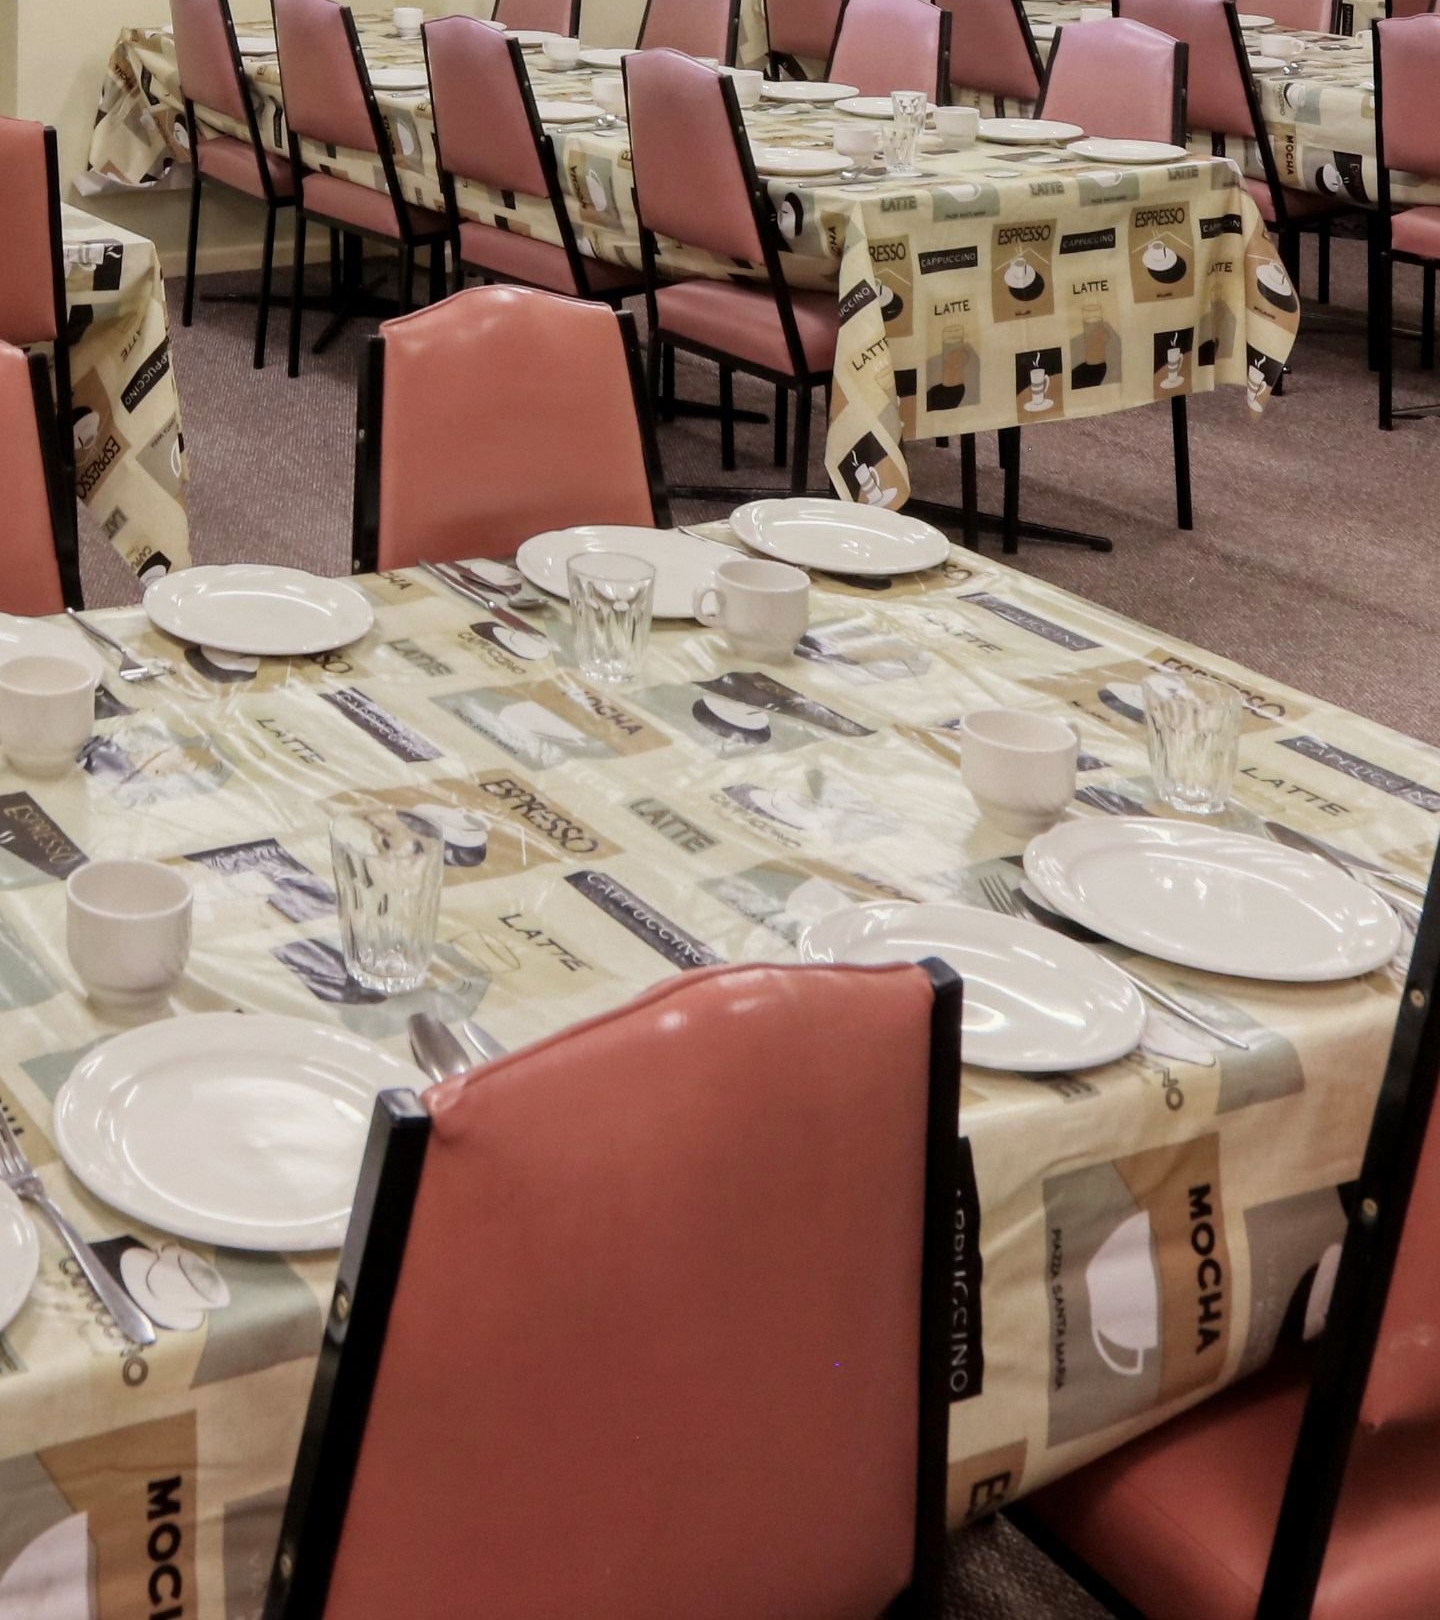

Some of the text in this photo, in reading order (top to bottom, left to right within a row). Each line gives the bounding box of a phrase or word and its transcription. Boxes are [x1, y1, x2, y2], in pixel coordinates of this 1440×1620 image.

[1285, 135, 1294, 175] MOCHA
[998, 225, 1051, 245] ESPRESSO
[1062, 234, 1114, 248] CAPPUCCINO
[1135, 208, 1185, 228] ESPRESSO
[870, 243, 906, 262] RESSO
[921, 252, 976, 268] CAPPUCCINO
[839, 287, 870, 318] UCCINO
[934, 300, 970, 316] LATTE
[1072, 281, 1109, 294] LATTE
[124, 353, 169, 406] PPUCCINO
[76, 436, 121, 500] ESPRESSO
[256, 718, 326, 764] LATTE
[1240, 766, 1351, 817] LATTE
[479, 778, 599, 852] ESPRESSO
[629, 797, 716, 854] LATTE
[498, 912, 592, 972] LATTE
[586, 873, 712, 966] CAPPUCCINO
[1188, 1184, 1223, 1356] MOCHA
[1051, 1286, 1067, 1338] SANTA
